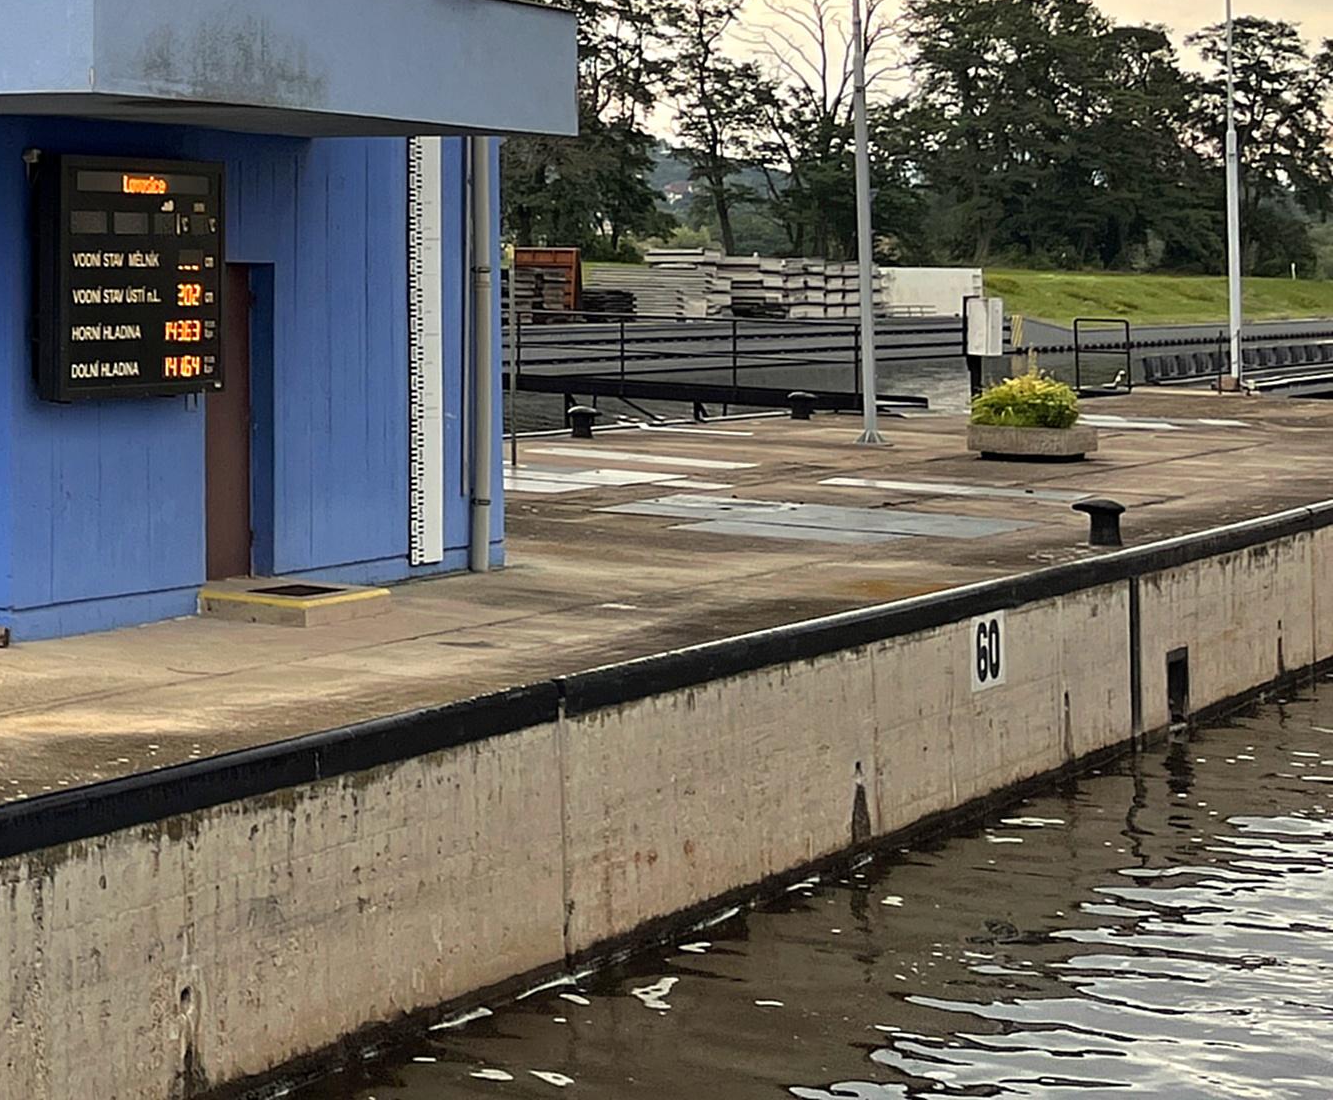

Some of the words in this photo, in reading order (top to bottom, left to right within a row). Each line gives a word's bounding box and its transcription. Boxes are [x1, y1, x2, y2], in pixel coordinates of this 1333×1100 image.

[103, 253, 124, 267] STAV
[103, 288, 124, 303] STAV
[72, 322, 101, 341] HORNÍ
[103, 324, 142, 341] HLADINA
[71, 359, 99, 379] DOLNÍ
[101, 361, 140, 377] HLADINA
[976, 618, 1001, 683] 60
